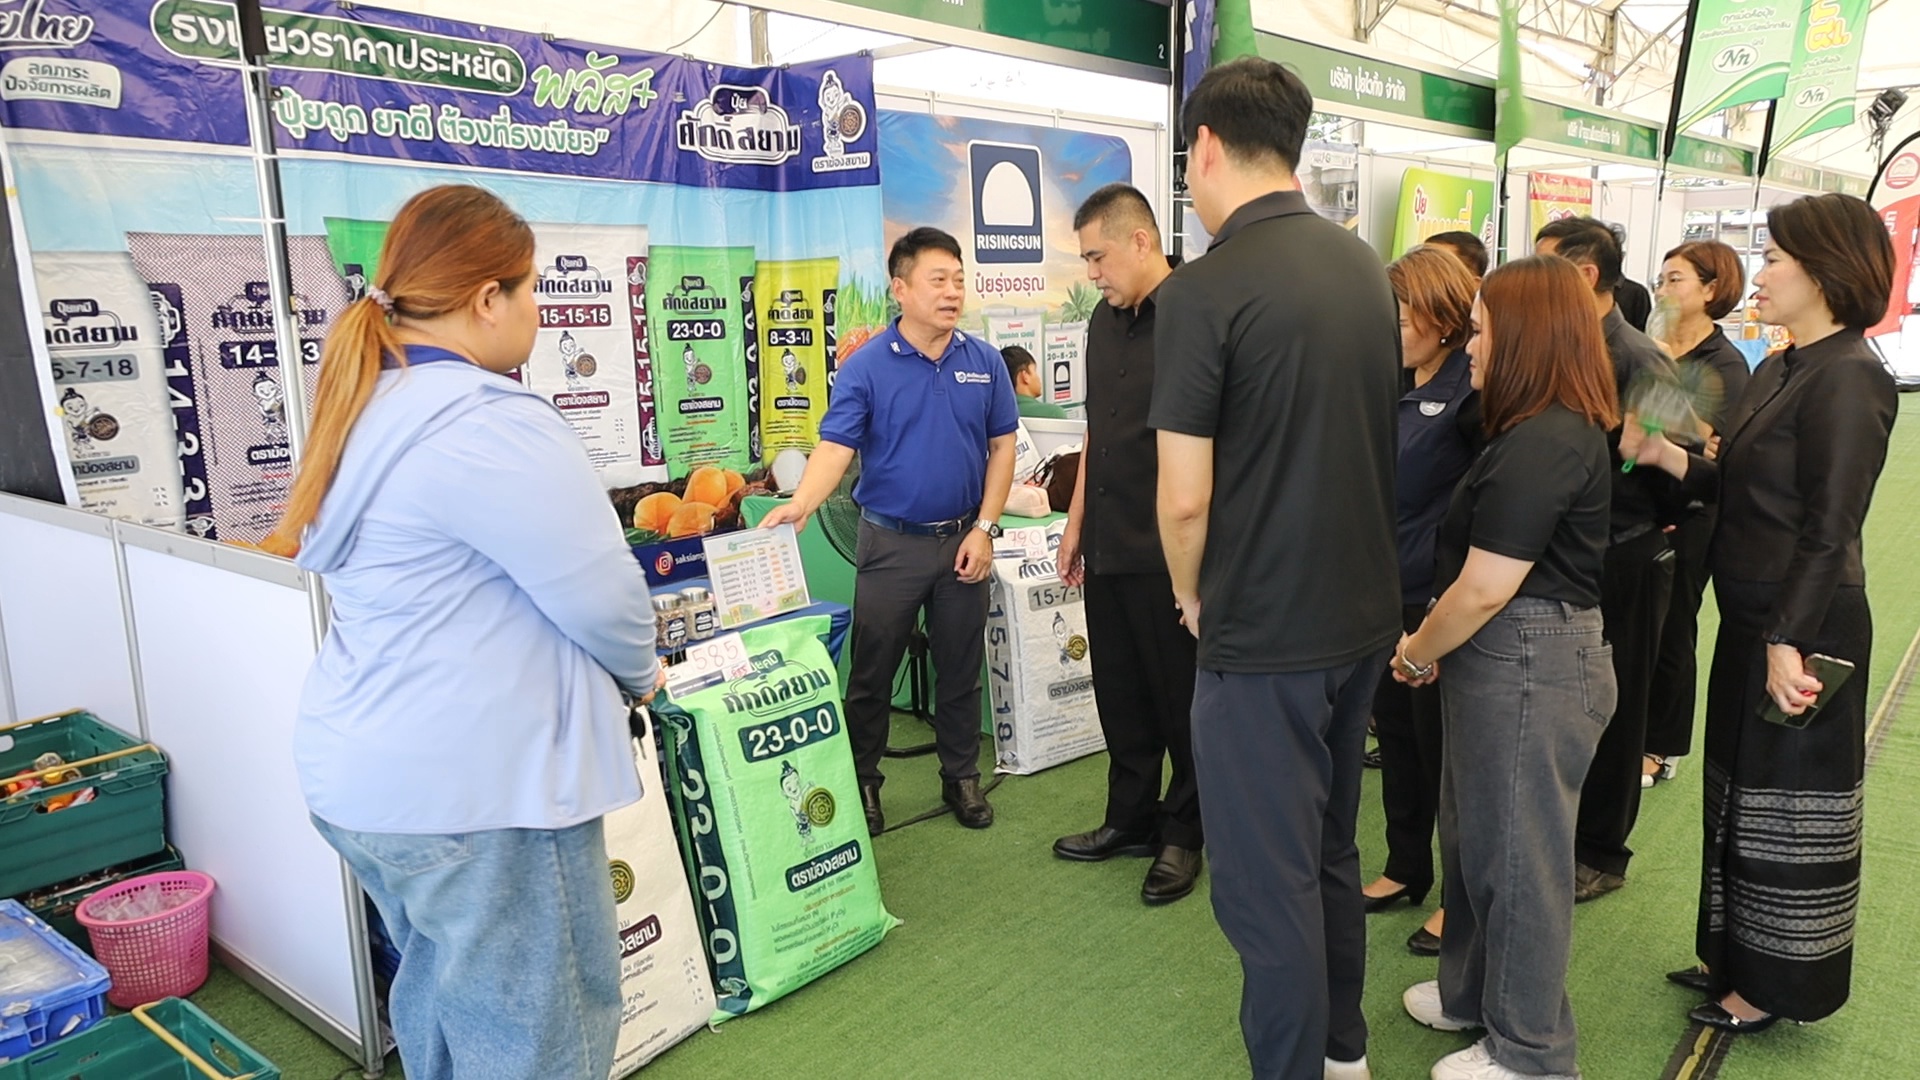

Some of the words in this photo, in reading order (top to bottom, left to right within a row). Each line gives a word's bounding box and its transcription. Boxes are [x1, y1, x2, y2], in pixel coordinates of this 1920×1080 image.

[171, 12, 512, 84] ธงเยวราคาประหยัด
[1158, 43, 1165, 60] 2
[29, 63, 89, 79] ลดภาระ
[5, 75, 111, 99] ปัจจัยการผลิต
[731, 93, 747, 113] ปุ๋ย
[374, 104, 432, 139] ยาดี
[977, 234, 1041, 250] RISINGSUN
[540, 308, 609, 325] 15-15-15
[671, 321, 722, 339] 23-0-0
[769, 330, 811, 345] 8-3-14
[230, 343, 320, 362] 14--3
[692, 640, 738, 670] 585
[988, 604, 1013, 743] 15-7-18
[748, 707, 833, 758] 23-0-0
